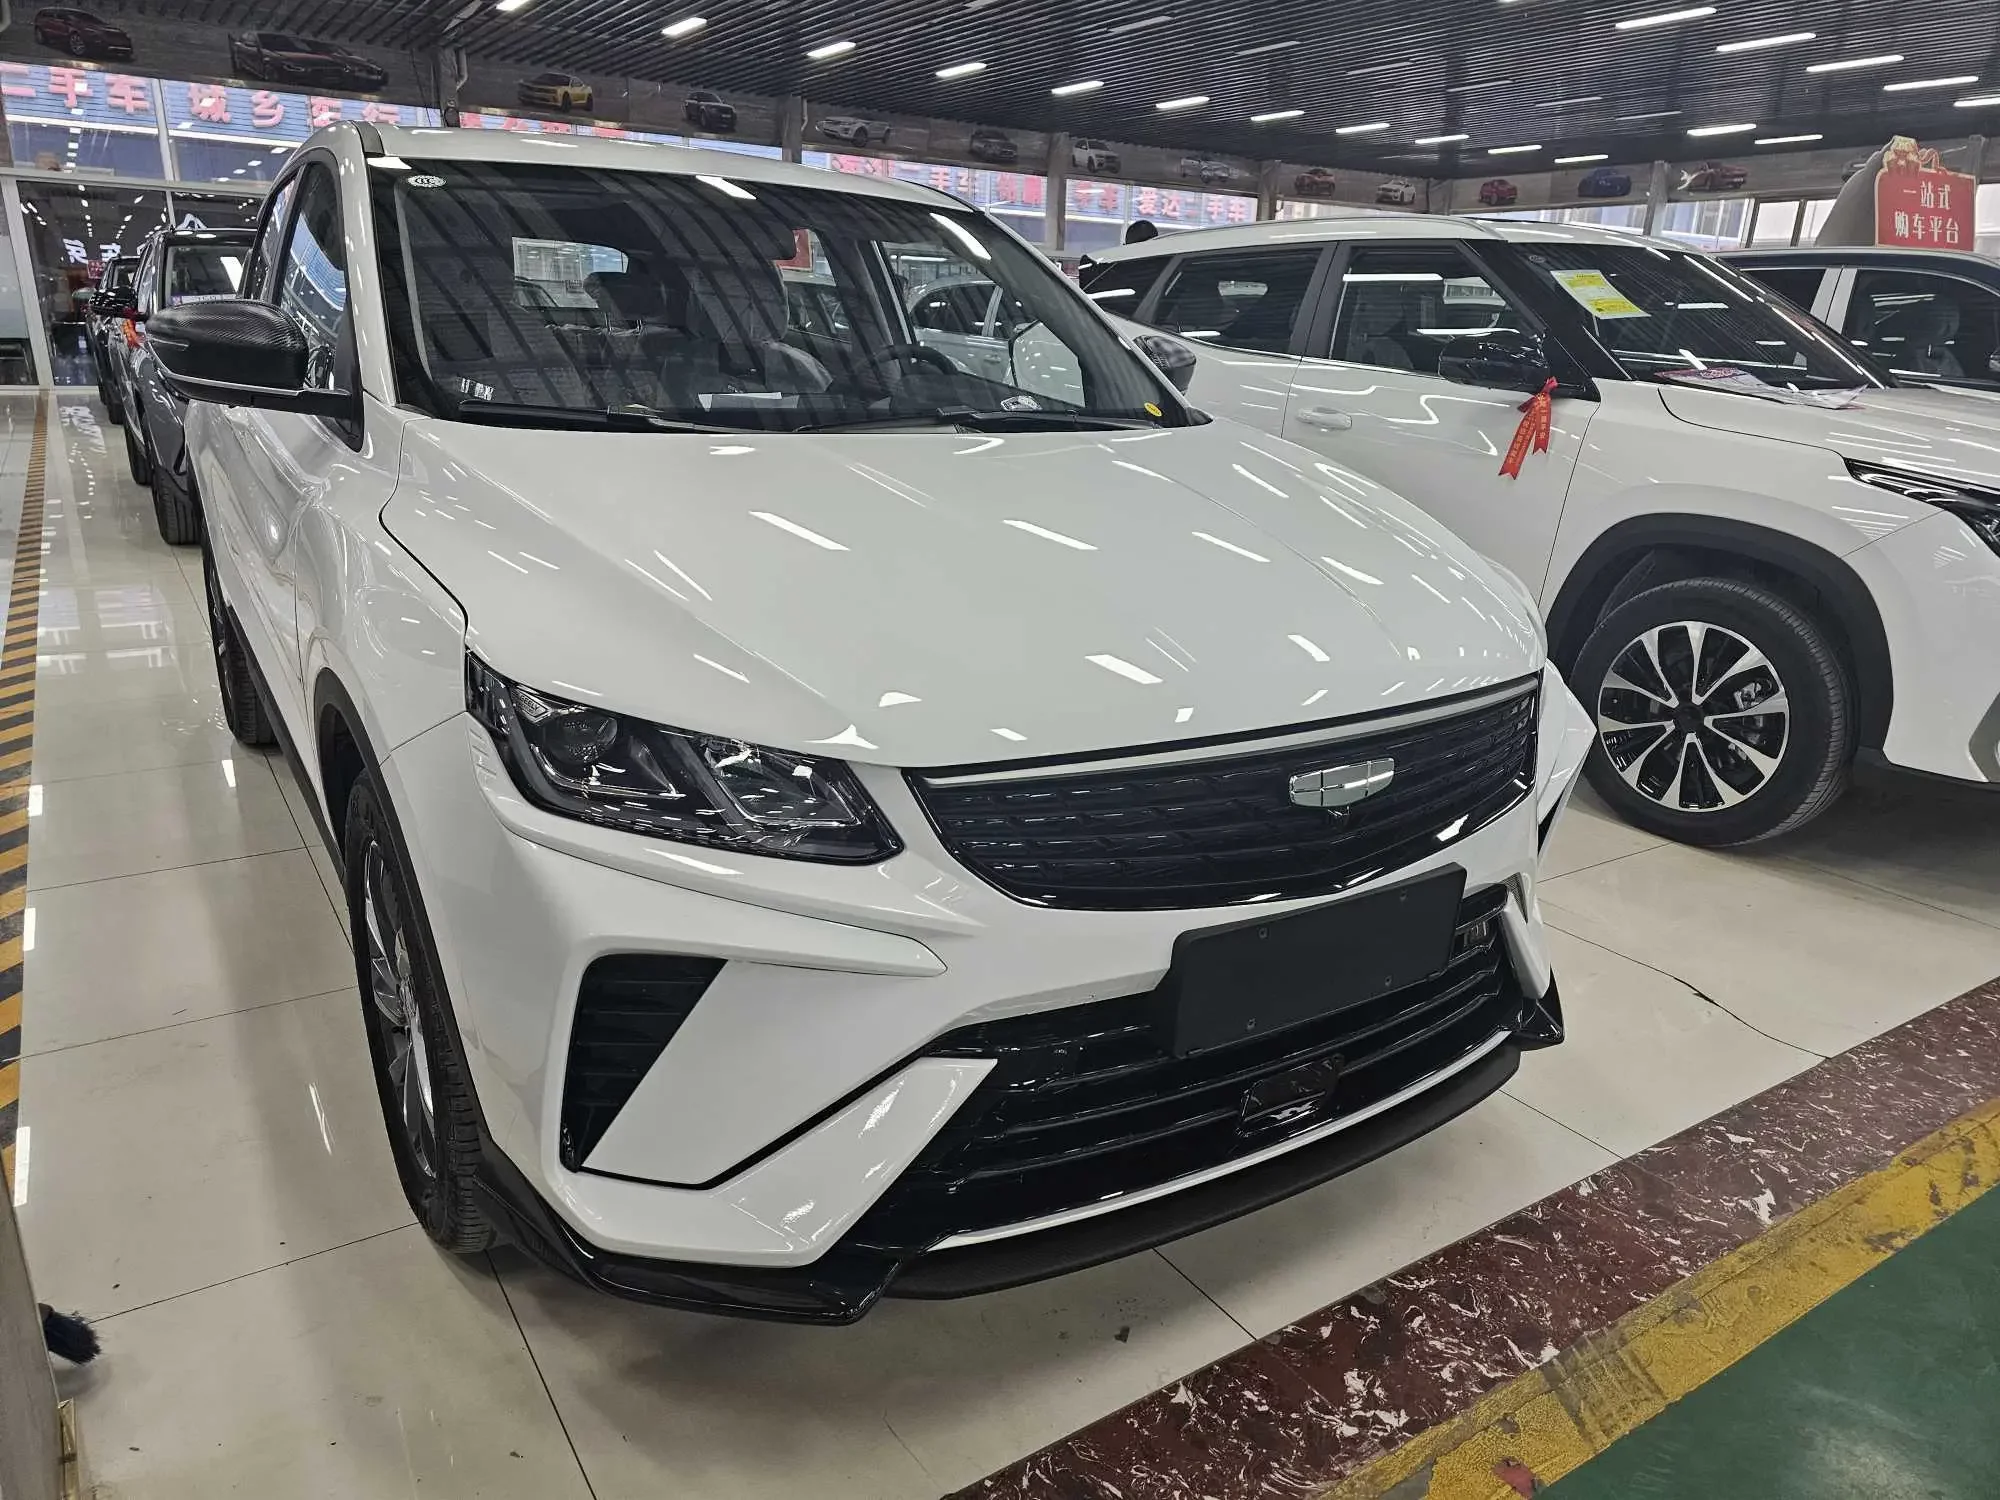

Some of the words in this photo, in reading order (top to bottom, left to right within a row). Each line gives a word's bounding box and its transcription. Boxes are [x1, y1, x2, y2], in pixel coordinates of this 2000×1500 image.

[0, 63, 150, 114] 二手车
[1903, 181, 1951, 210] 一站式
[1894, 211, 1960, 244] 购车平台
